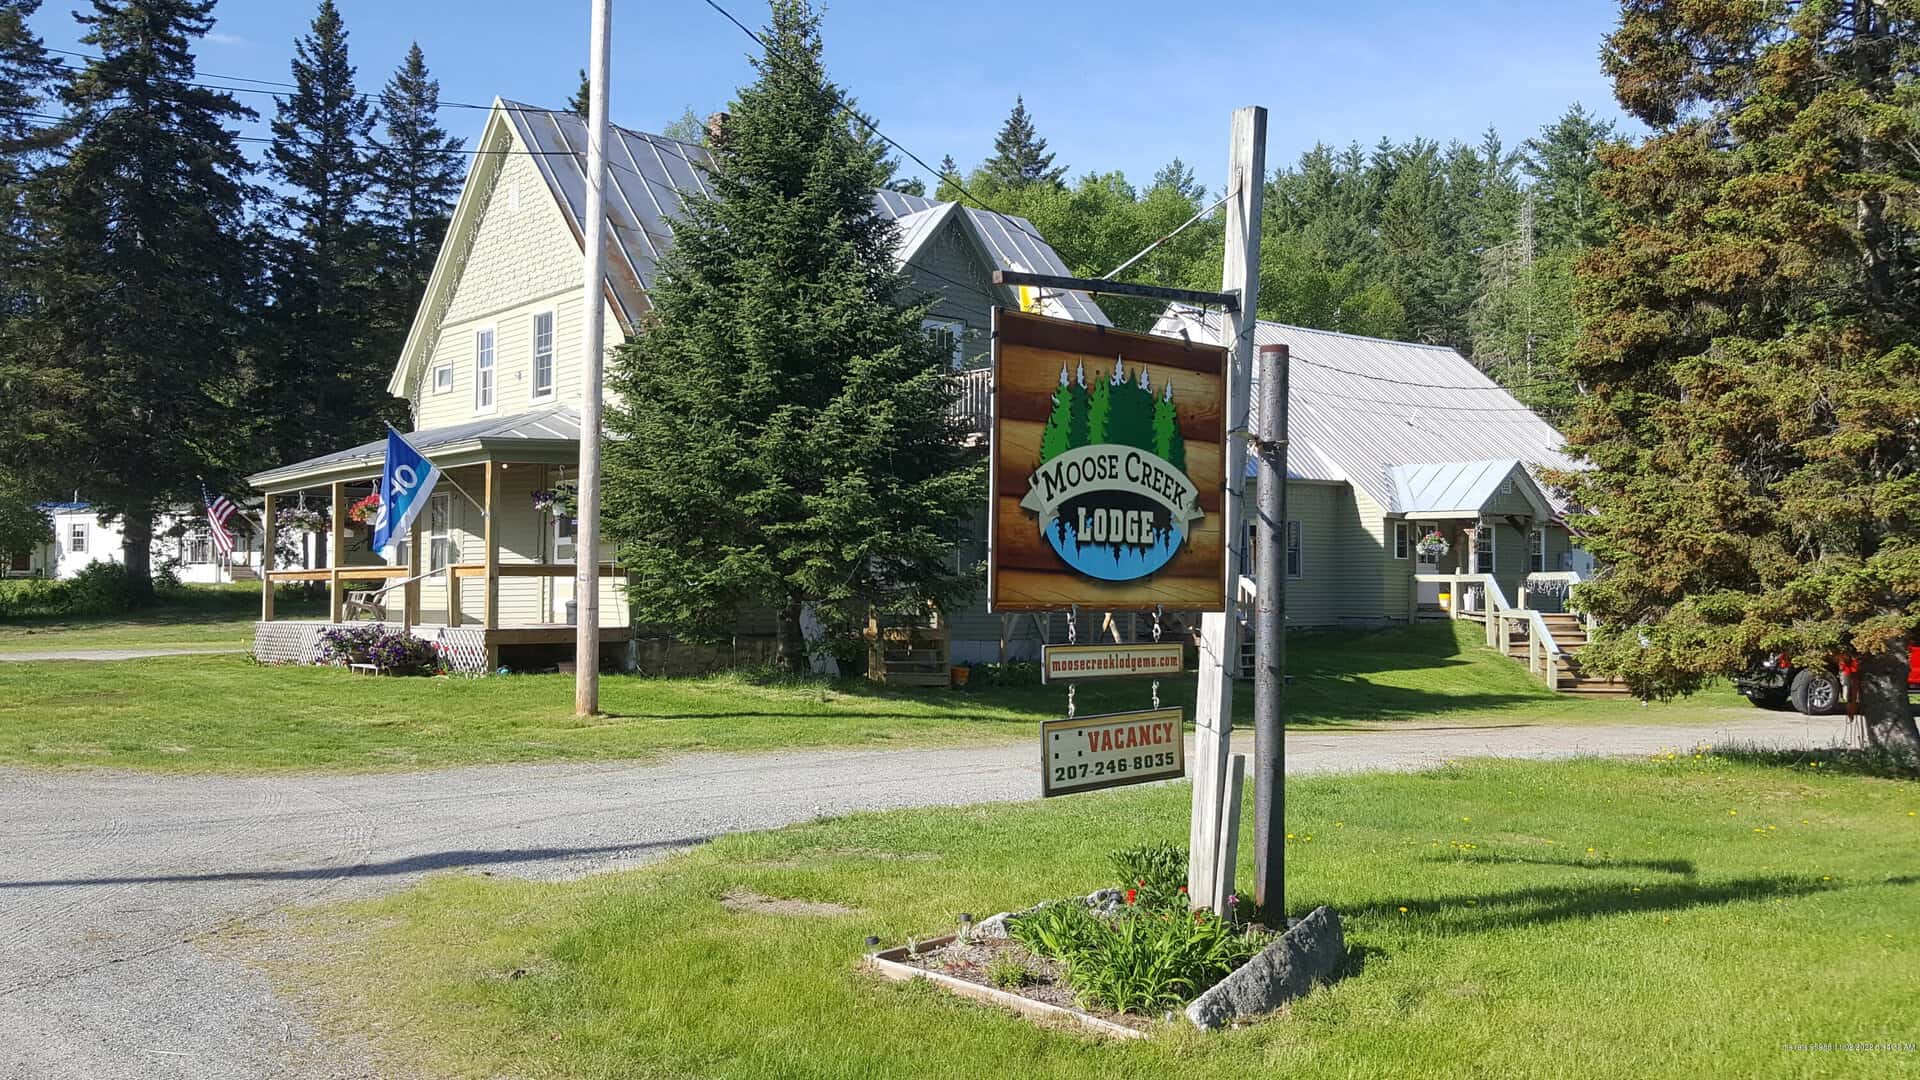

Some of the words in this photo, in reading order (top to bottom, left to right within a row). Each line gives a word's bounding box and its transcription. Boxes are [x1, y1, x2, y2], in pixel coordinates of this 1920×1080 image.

[1042, 454, 1119, 502] MOOSE
[1125, 452, 1187, 510] CREEK
[1077, 507, 1154, 544] LODGE
[1052, 653, 1178, 672] moosecreeklodgeme.com
[1088, 722, 1173, 753] VACANCY
[1055, 752, 1174, 781] 207-246-8035
